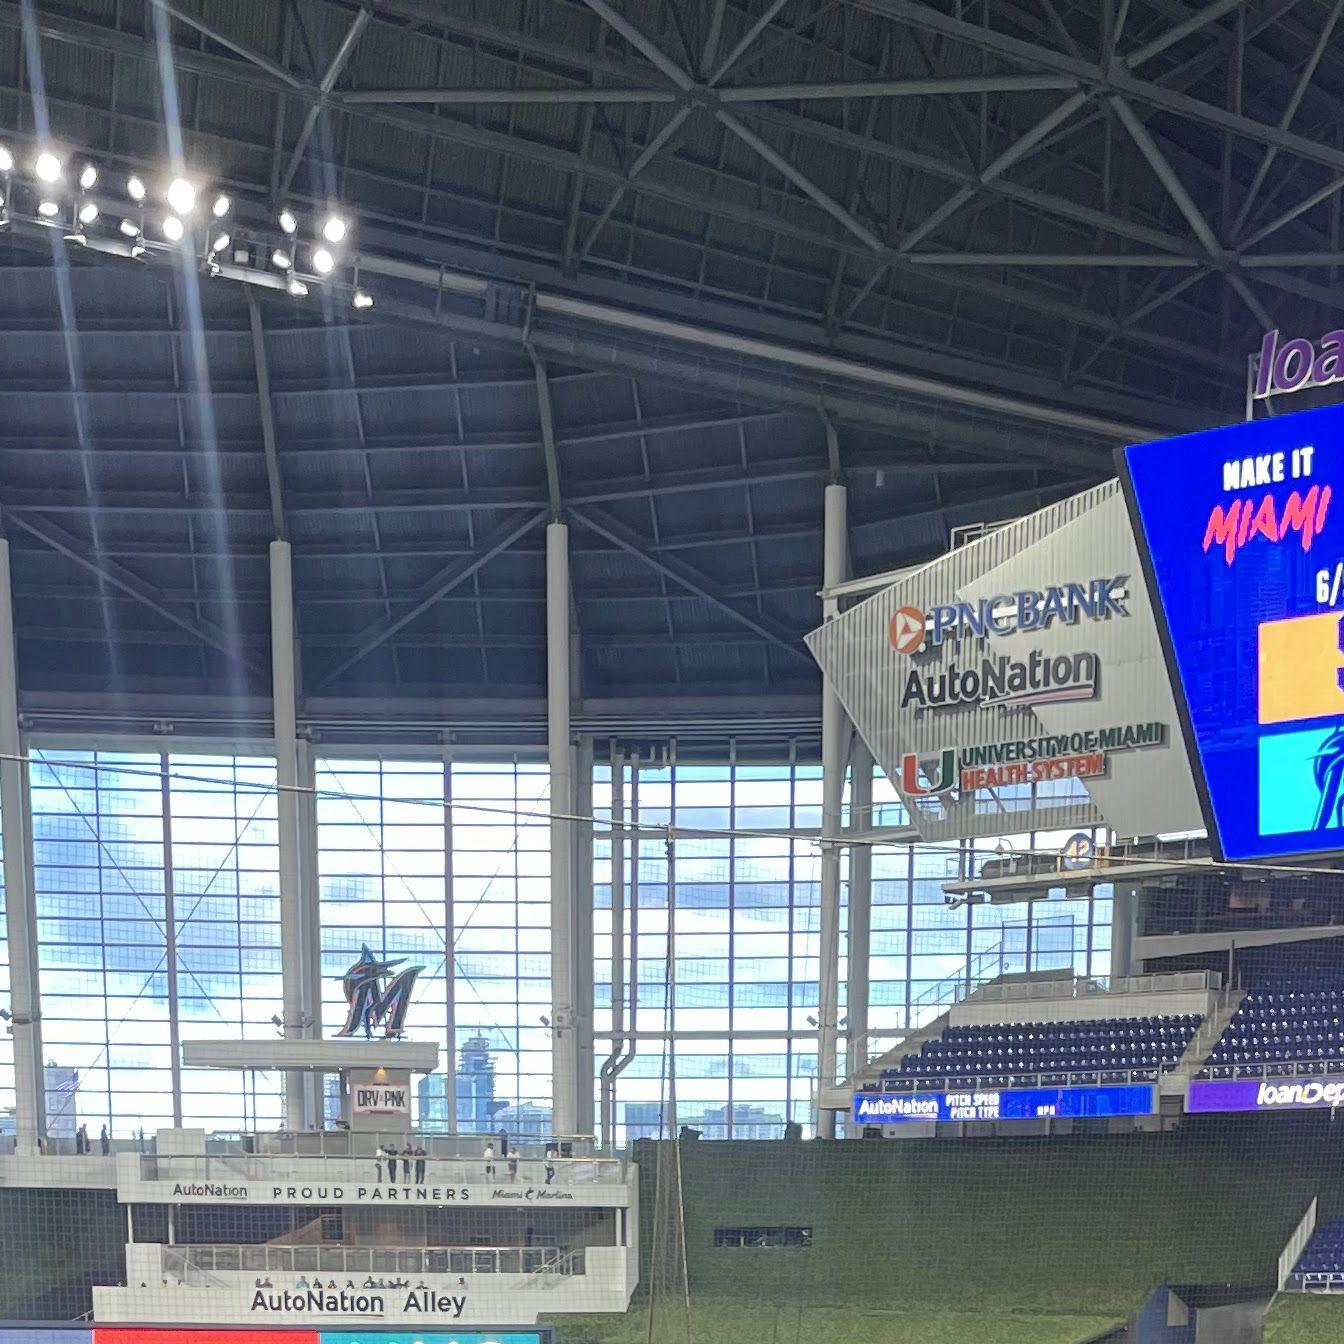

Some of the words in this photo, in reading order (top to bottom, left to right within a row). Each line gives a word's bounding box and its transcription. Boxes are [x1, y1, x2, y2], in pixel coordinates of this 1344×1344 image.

[1223, 452, 1285, 491] MAKE
[1292, 446, 1314, 479] IT
[1203, 485, 1332, 568] MIAMI
[901, 650, 1097, 709] AutoNation
[962, 733, 1068, 768] UNIVERSITY
[1070, 729, 1097, 754] OF
[1099, 722, 1163, 749] MIAMI
[961, 766, 1028, 792] HEALTH
[1031, 752, 1105, 782] SYSTEM
[384, 1089, 406, 1107] PNK
[859, 1098, 939, 1116] AutoNation
[946, 1094, 971, 1107] PITCH
[950, 1106, 976, 1119] PITCH
[173, 1183, 247, 1197] AutoNation
[273, 1186, 345, 1199] PROUD
[357, 1186, 471, 1200] PARTNERS
[251, 1289, 385, 1312] AutoNation
[403, 1291, 468, 1318] Alley
